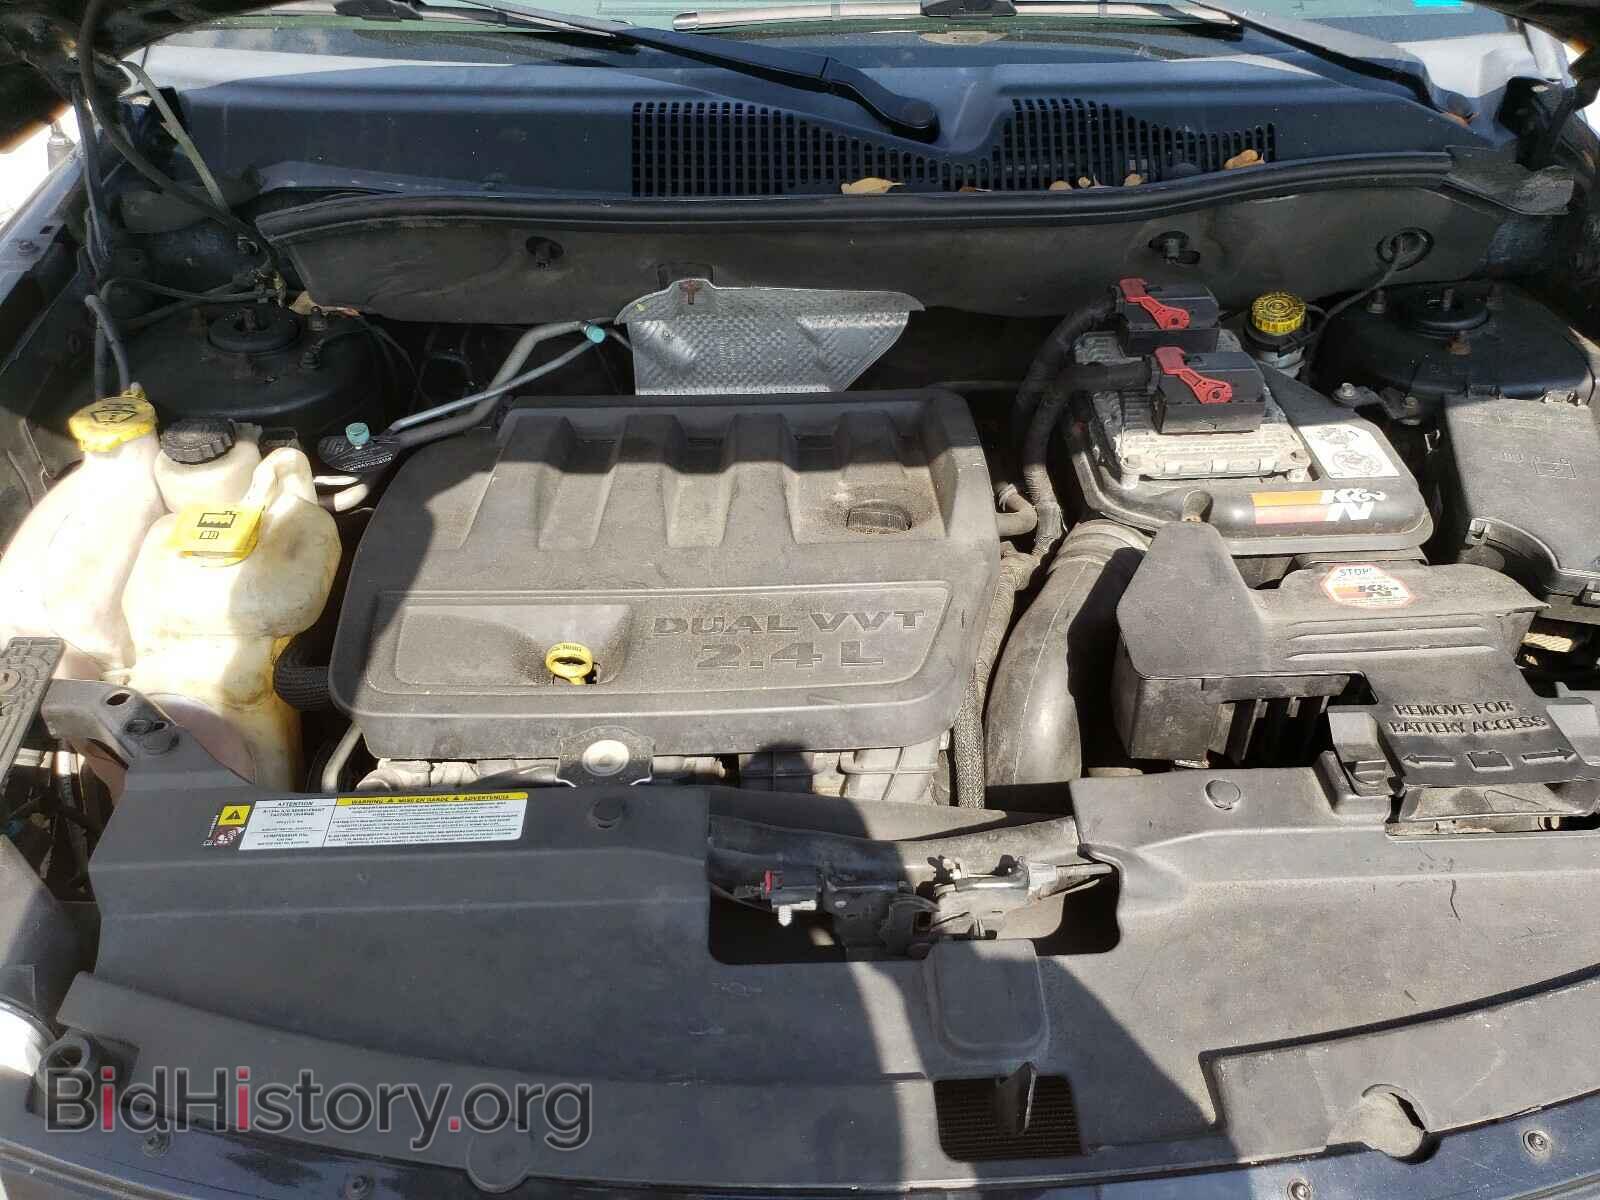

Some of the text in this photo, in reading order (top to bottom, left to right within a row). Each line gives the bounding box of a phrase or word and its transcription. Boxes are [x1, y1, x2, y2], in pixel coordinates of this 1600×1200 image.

[653, 609, 926, 636] DUAL VVT
[697, 640, 884, 669] 2.4 L
[1393, 700, 1515, 718] REMOVE FOR
[1388, 715, 1549, 735] BATTERY ACCESS
